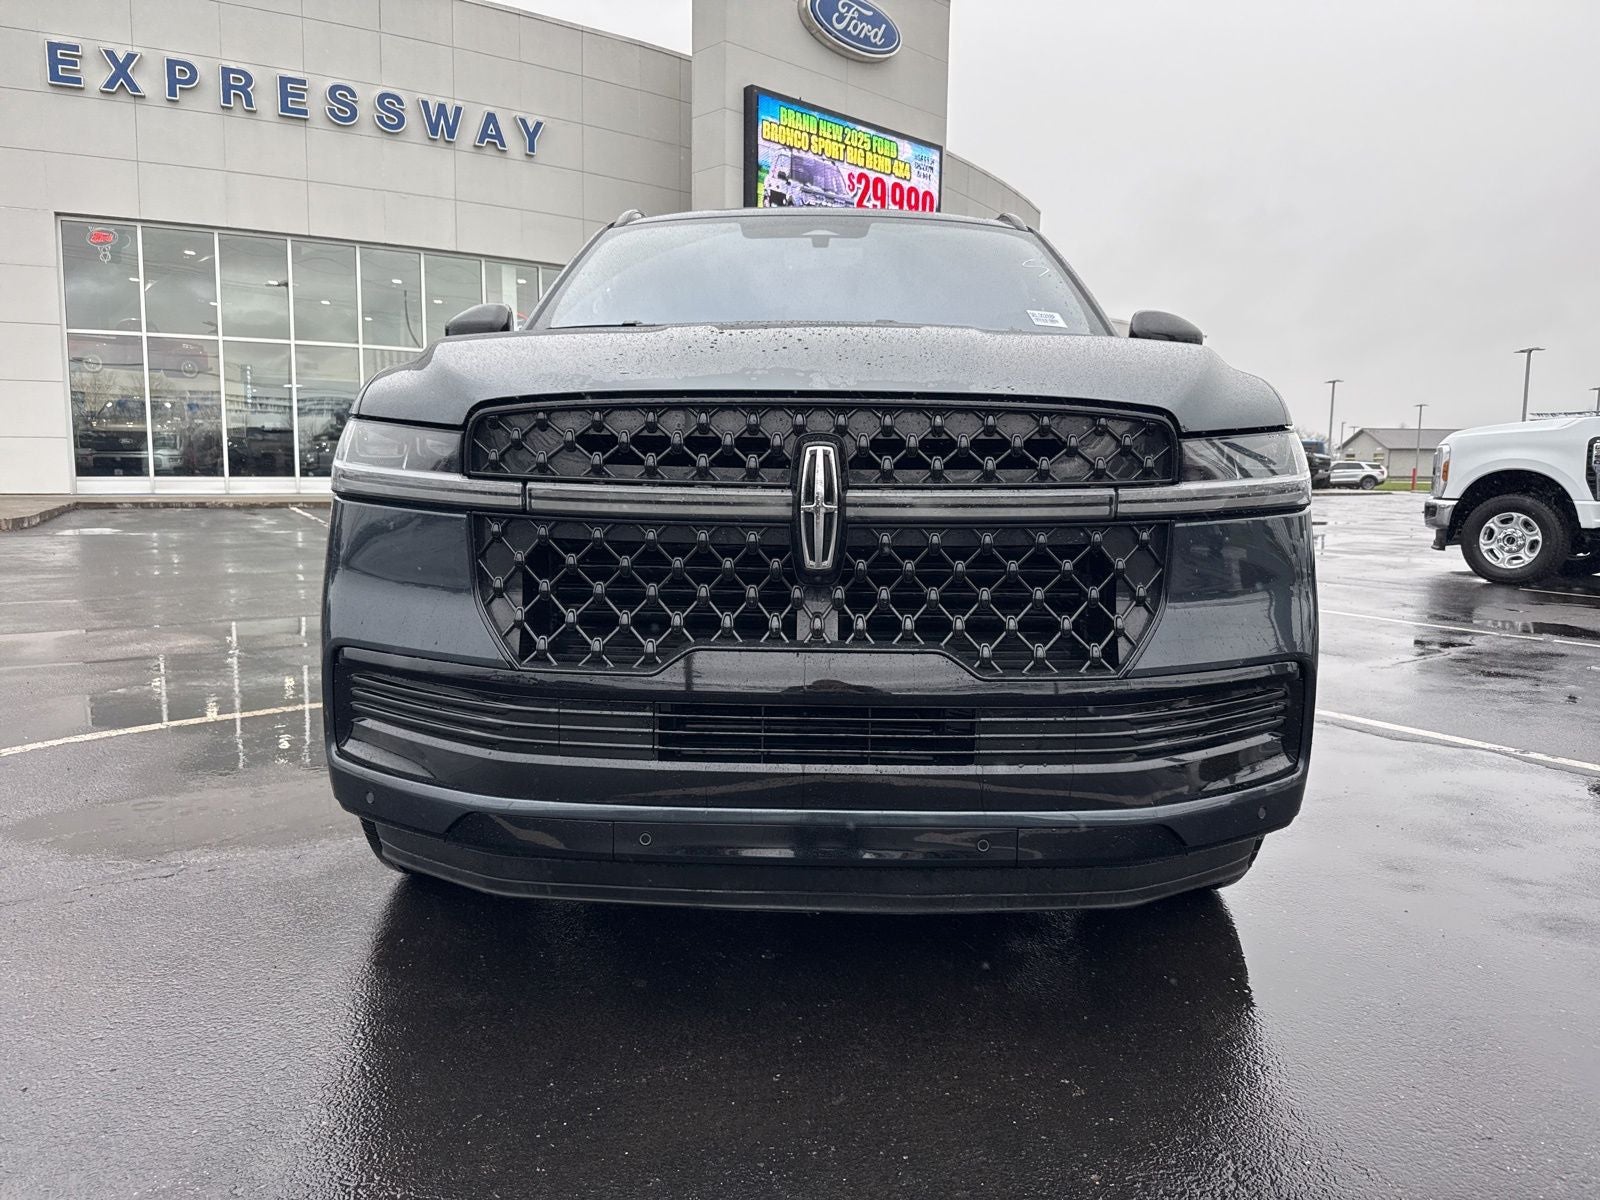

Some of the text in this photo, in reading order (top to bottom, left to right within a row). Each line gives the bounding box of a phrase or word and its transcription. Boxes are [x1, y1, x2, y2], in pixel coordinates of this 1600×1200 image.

[832, 0, 886, 45] Ford
[45, 39, 546, 157] EXPRESSWAY
[762, 119, 809, 152] BRONCO
[810, 134, 845, 162] SPORT
[846, 145, 865, 168] BIG
[865, 151, 892, 175] BEND
[779, 105, 898, 159] BRAND NEW 2025 FORD
[847, 172, 935, 212] $29990
